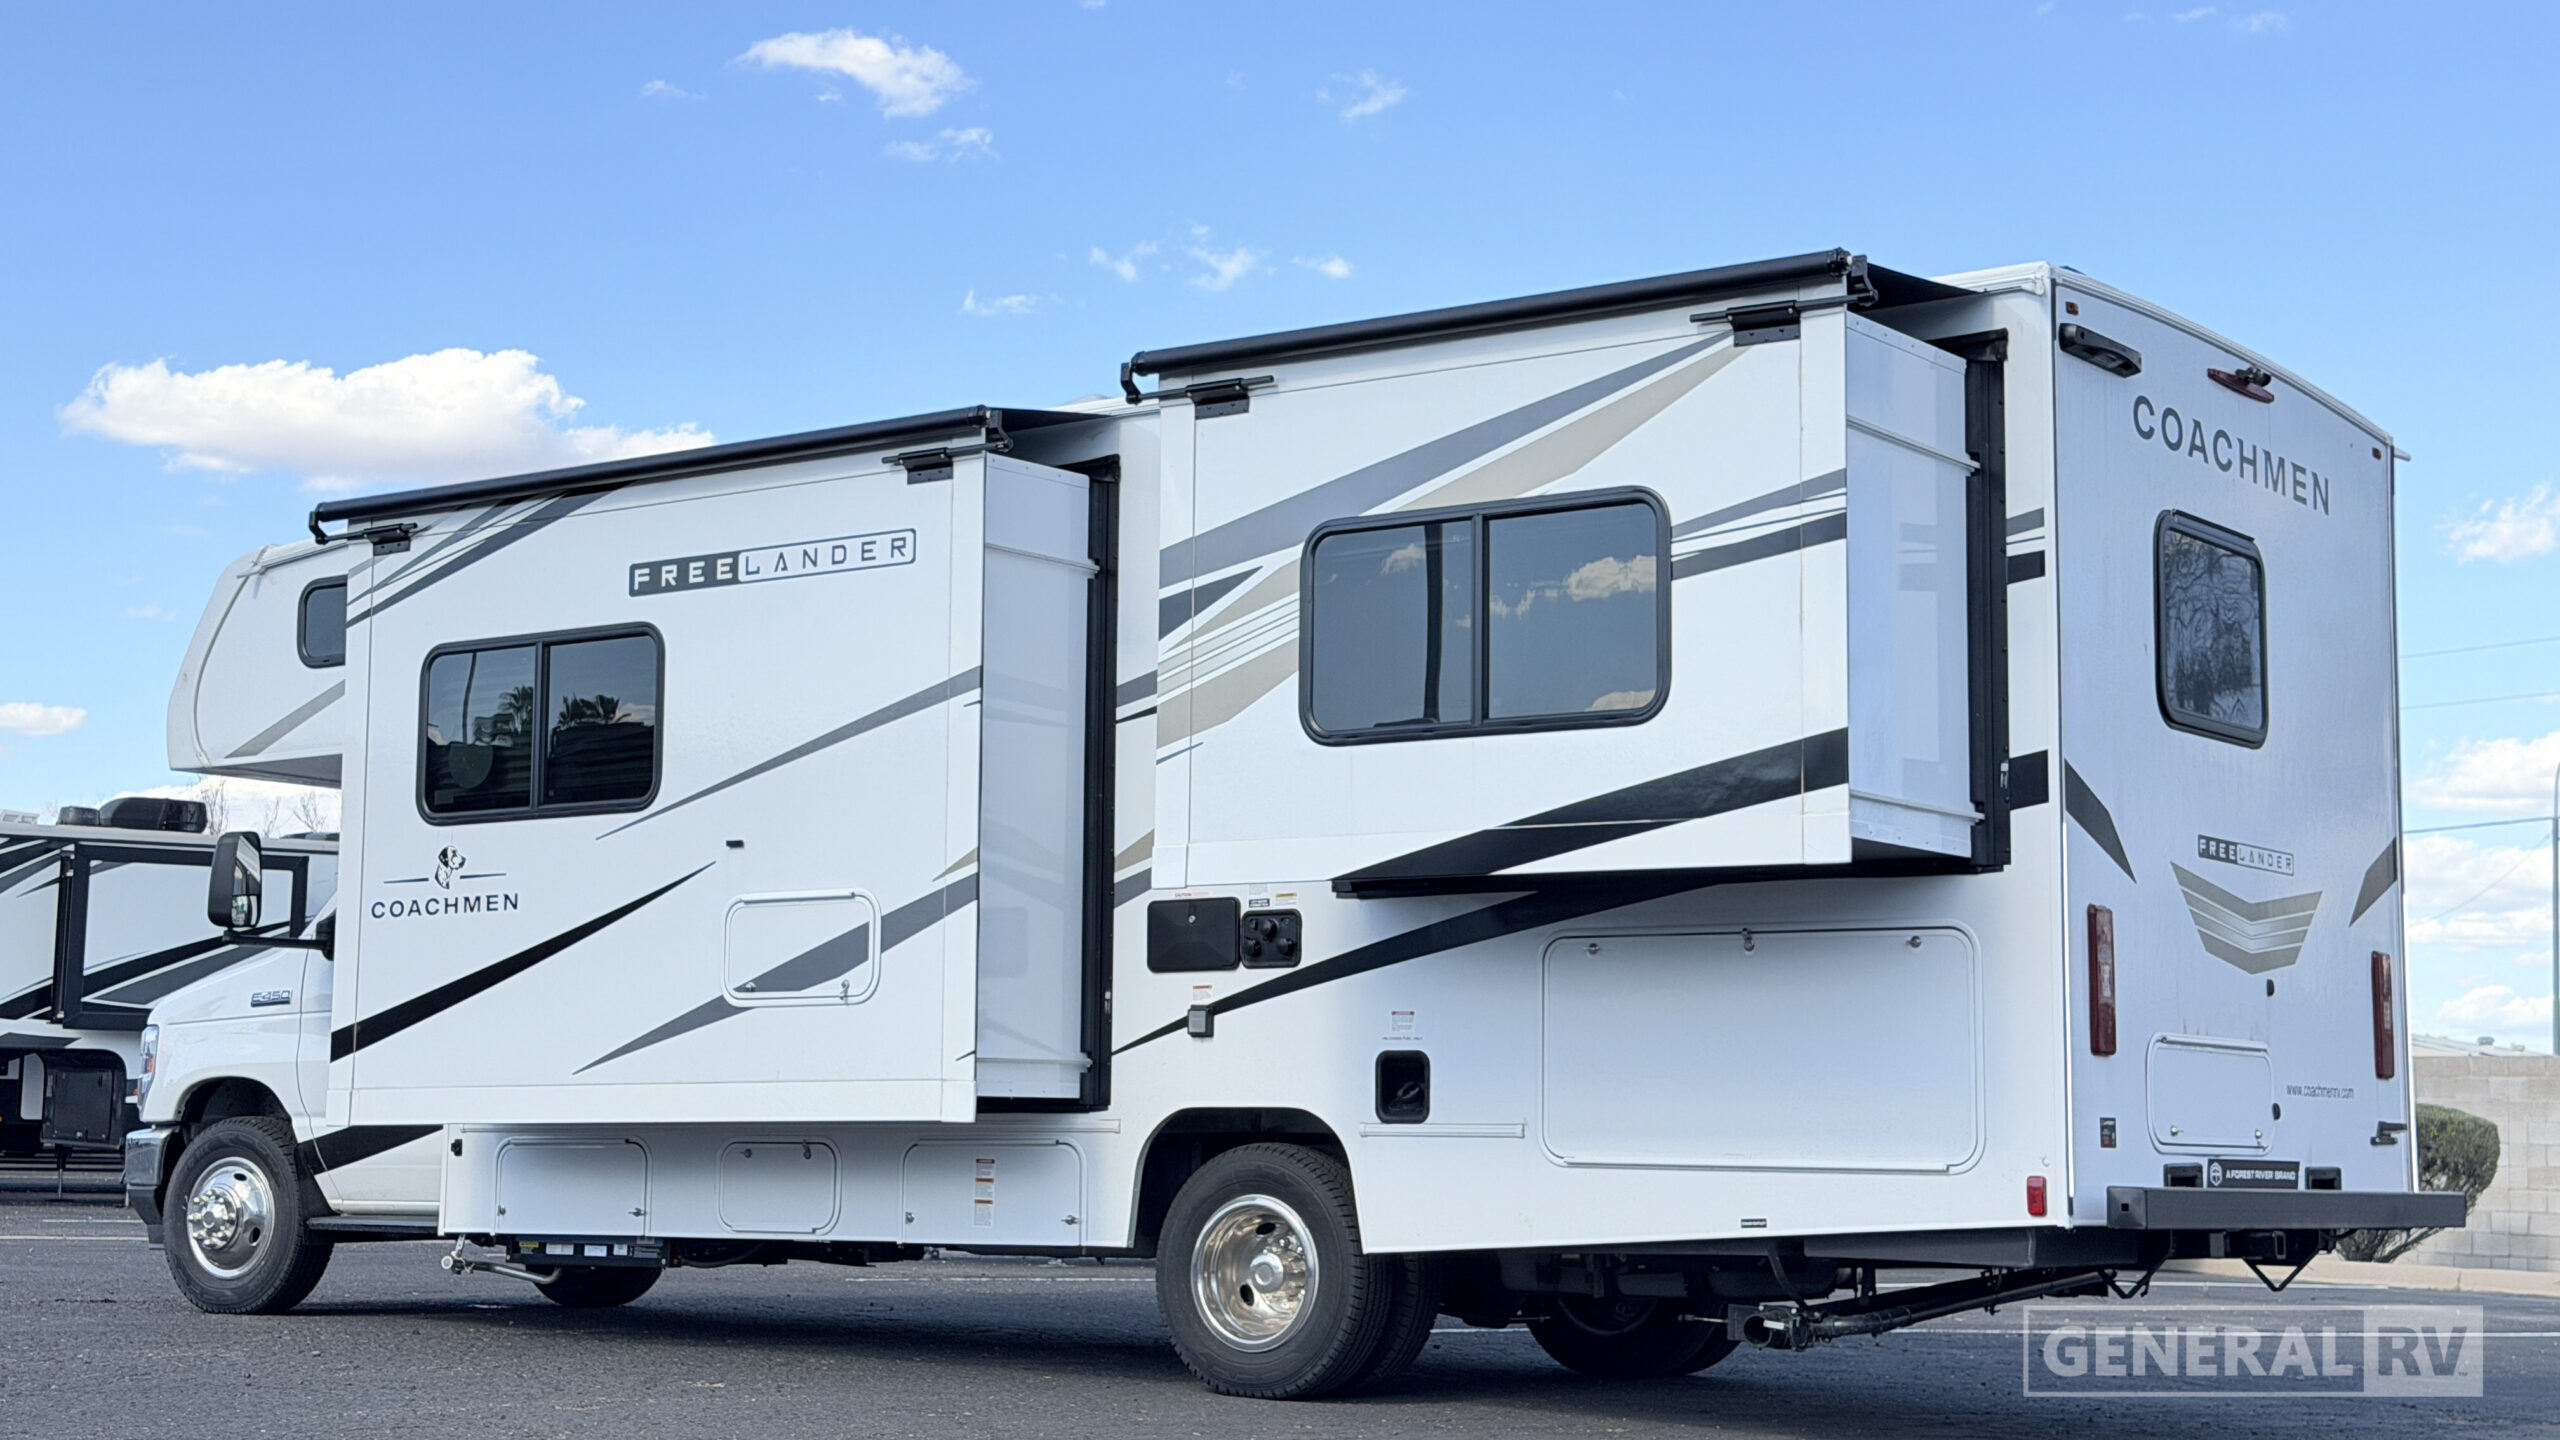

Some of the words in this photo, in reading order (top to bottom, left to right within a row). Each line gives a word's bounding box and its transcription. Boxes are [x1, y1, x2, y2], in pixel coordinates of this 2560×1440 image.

[2133, 395, 2330, 516] COACHMEN
[633, 536, 908, 591] FREELANDER
[371, 892, 519, 919] COACHMEN
[2231, 1169, 2255, 1180] FOREST
[2255, 1170, 2274, 1180] RIVER
[2275, 1170, 2297, 1181] BRAND
